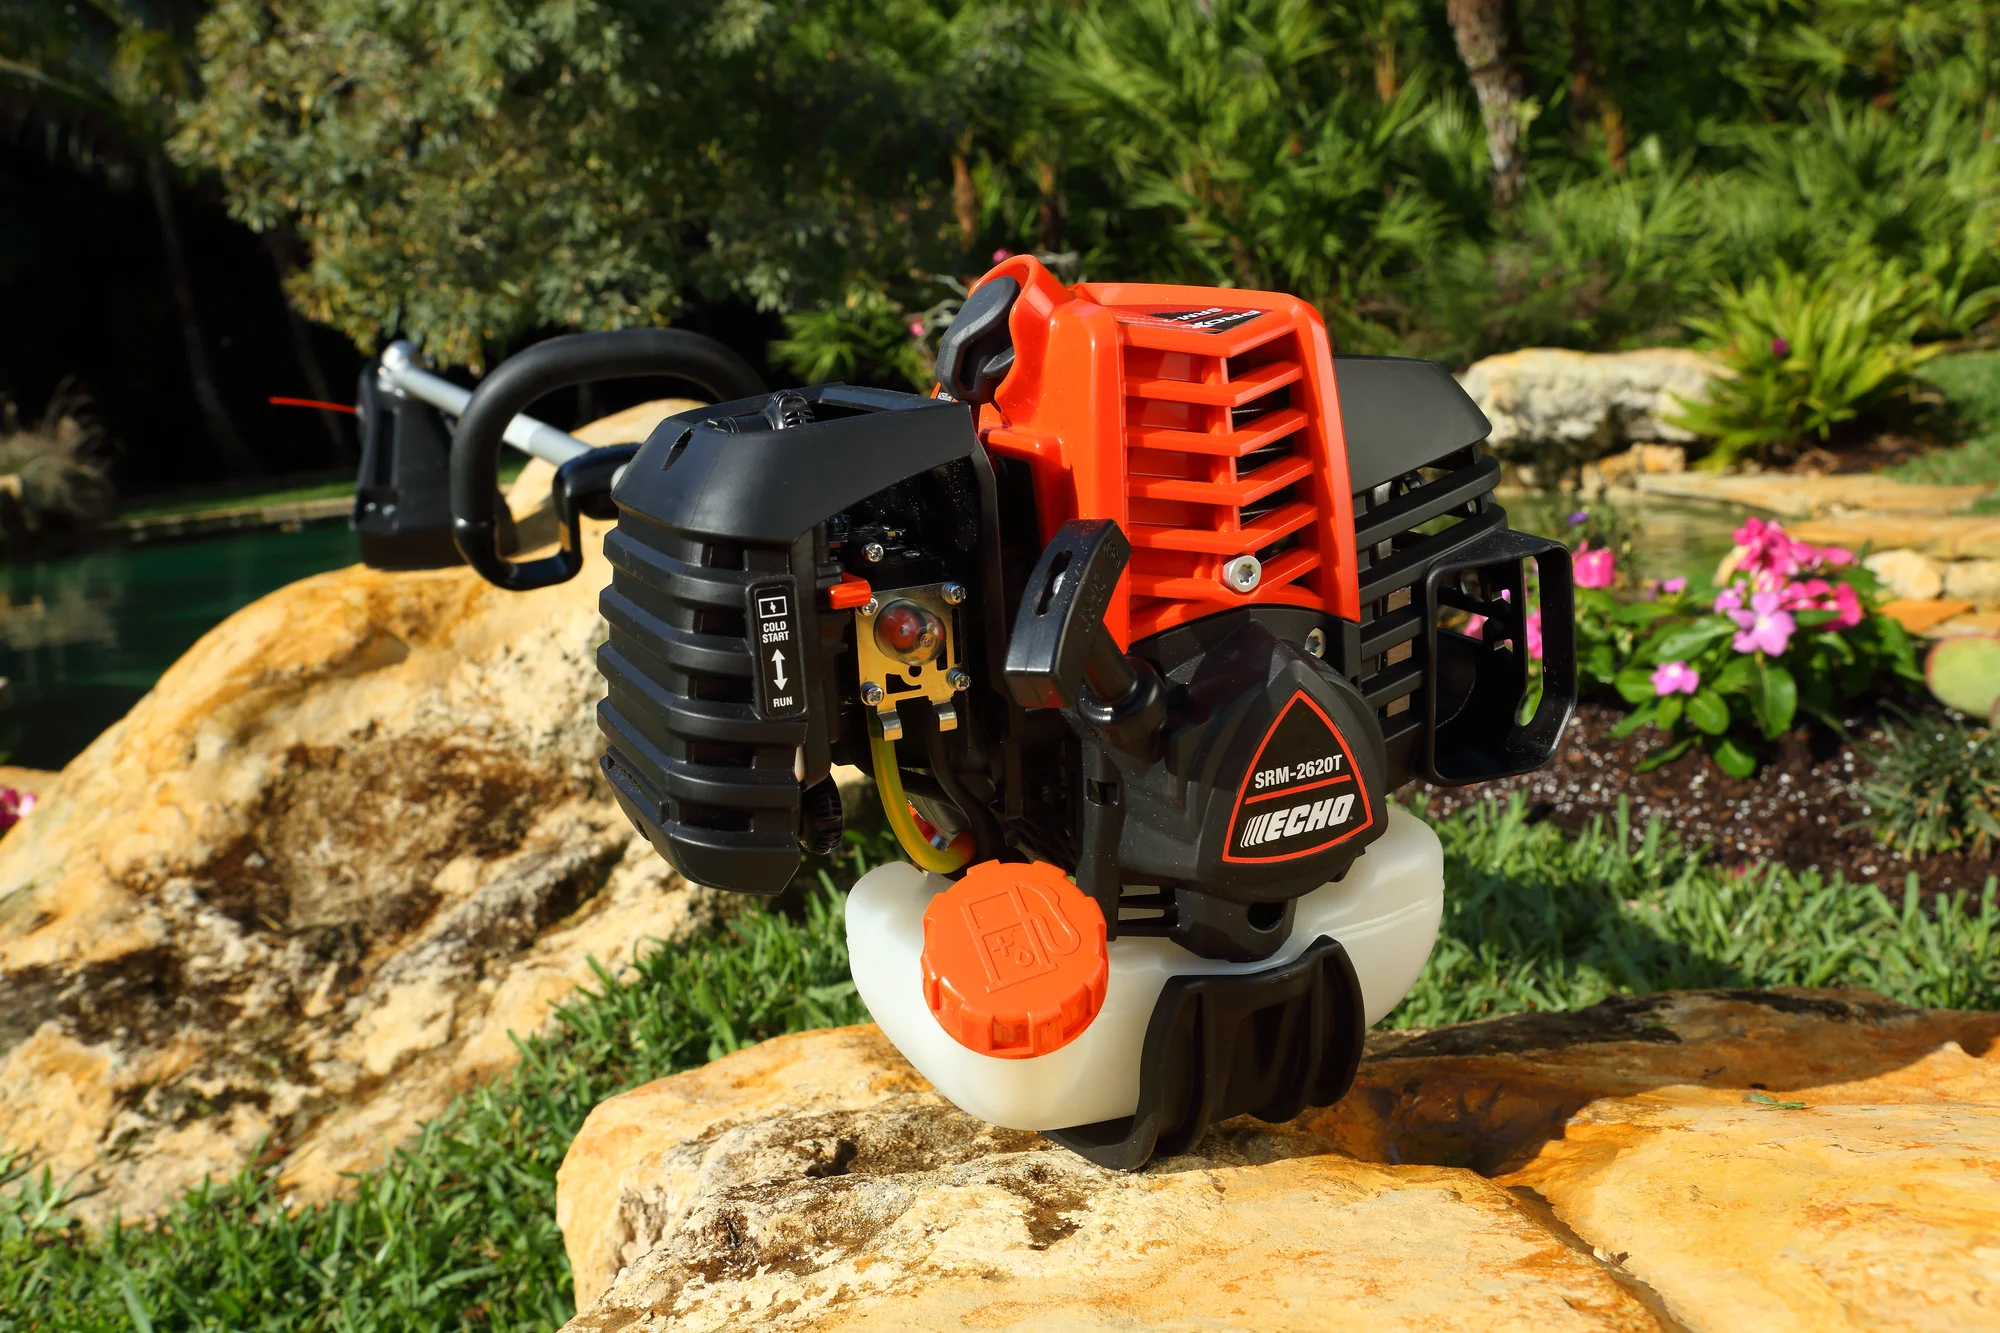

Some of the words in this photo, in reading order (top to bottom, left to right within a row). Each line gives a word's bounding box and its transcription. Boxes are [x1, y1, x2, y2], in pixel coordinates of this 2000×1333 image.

[763, 621, 787, 633] COLD
[762, 631, 790, 644] START
[773, 696, 793, 708] RUN
[1254, 754, 1343, 789] SRM-2620T
[1264, 793, 1356, 842] ECHO
